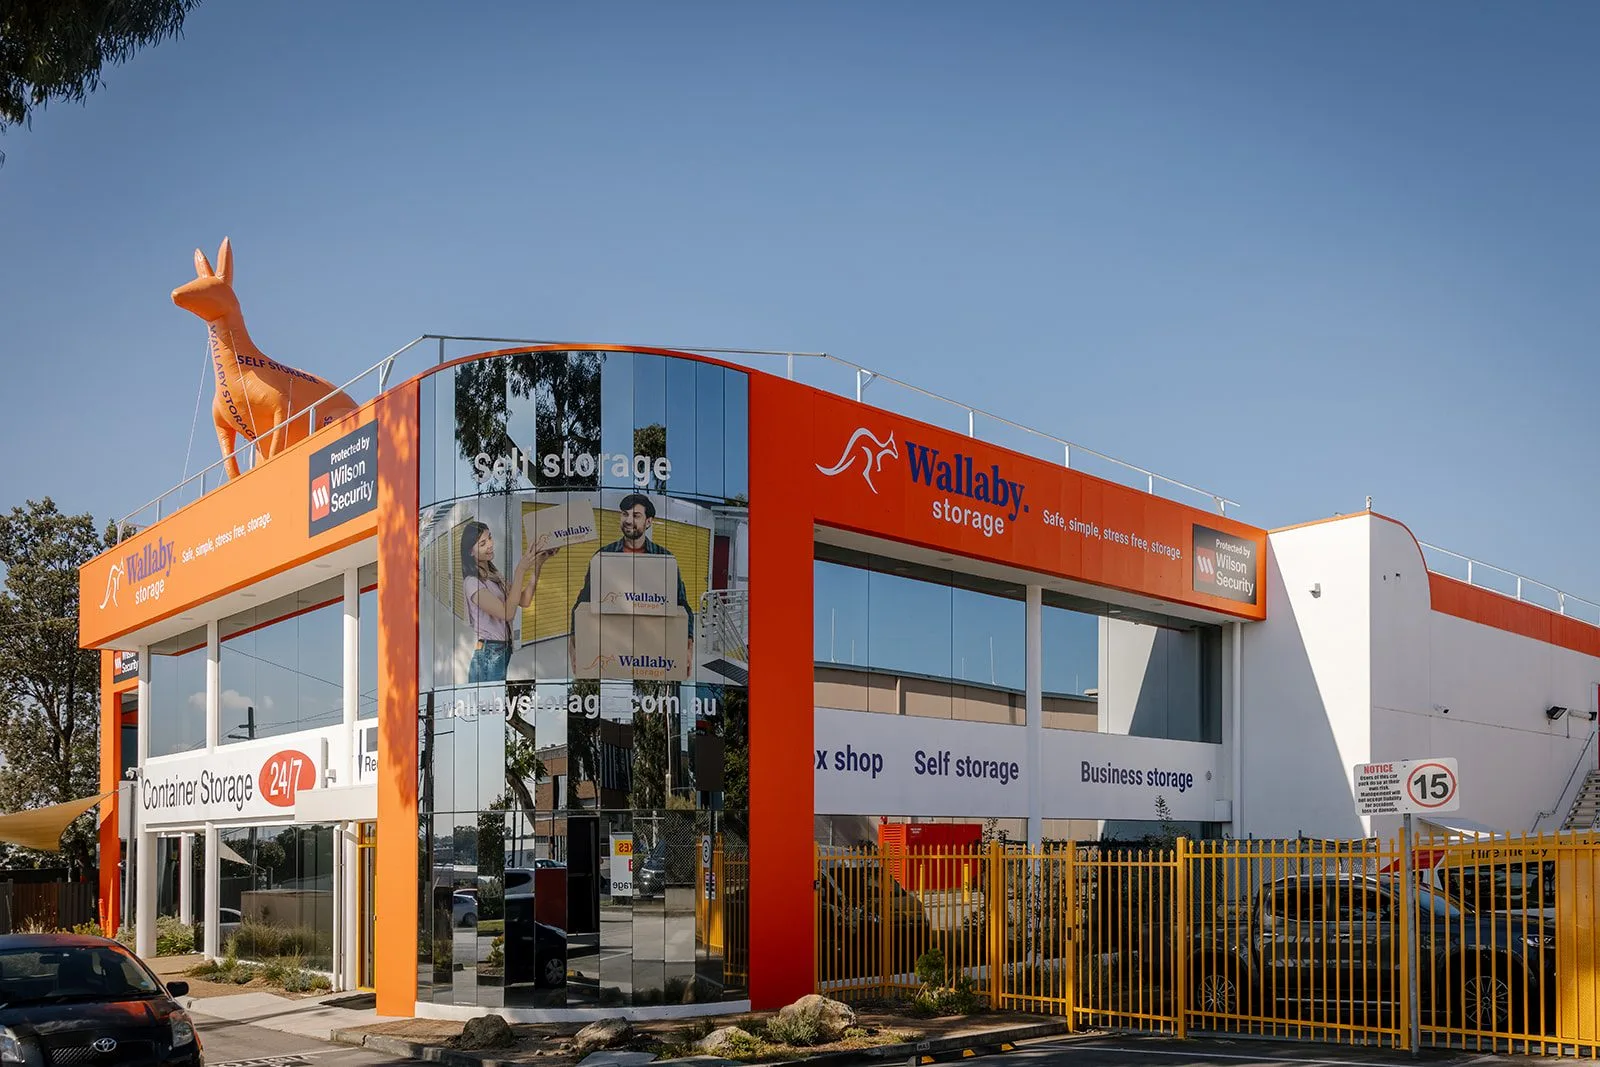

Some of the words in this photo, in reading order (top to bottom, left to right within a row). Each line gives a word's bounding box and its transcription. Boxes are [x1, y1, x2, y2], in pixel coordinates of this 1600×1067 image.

[210, 324, 228, 387] WALLABY
[237, 355, 265, 368] SELF
[268, 361, 319, 384] STORAGE
[330, 439, 361, 465] Protected
[361, 437, 371, 451] by
[331, 460, 366, 489] Wilson
[474, 446, 533, 483] Self
[543, 450, 672, 486] storage
[905, 440, 1029, 522] Wallaby.
[331, 480, 374, 513] Security
[215, 530, 232, 547] stress
[247, 512, 272, 532] storage.
[553, 525, 593, 539] Wallaby.
[932, 498, 1004, 537] storage
[1043, 509, 1068, 532] Safe,
[1069, 518, 1101, 541] simple,
[1103, 528, 1129, 545] stress
[1131, 534, 1149, 552] free,
[1151, 541, 1183, 561] storage.
[1215, 539, 1243, 556] Protected
[1243, 546, 1251, 559] by
[126, 537, 176, 585] Wallaby.
[1216, 552, 1247, 574] Wilson
[135, 579, 165, 605] storage
[624, 592, 669, 605] Wallaby.
[1216, 572, 1254, 596] Security
[619, 655, 677, 671] Wallaby.
[441, 692, 717, 720] wallabystoragcom.au
[365, 756, 378, 772] Re
[834, 744, 884, 779] shop
[914, 750, 950, 776] Self
[956, 755, 1019, 785] storage
[1364, 764, 1393, 774] NOTICE
[143, 774, 198, 811] Container
[201, 769, 253, 812] Storage
[270, 759, 302, 799] 24/7
[1081, 760, 1143, 786] Business
[1146, 767, 1193, 793] storage
[1413, 773, 1449, 800] 15
[1471, 847, 1500, 860] Hire
